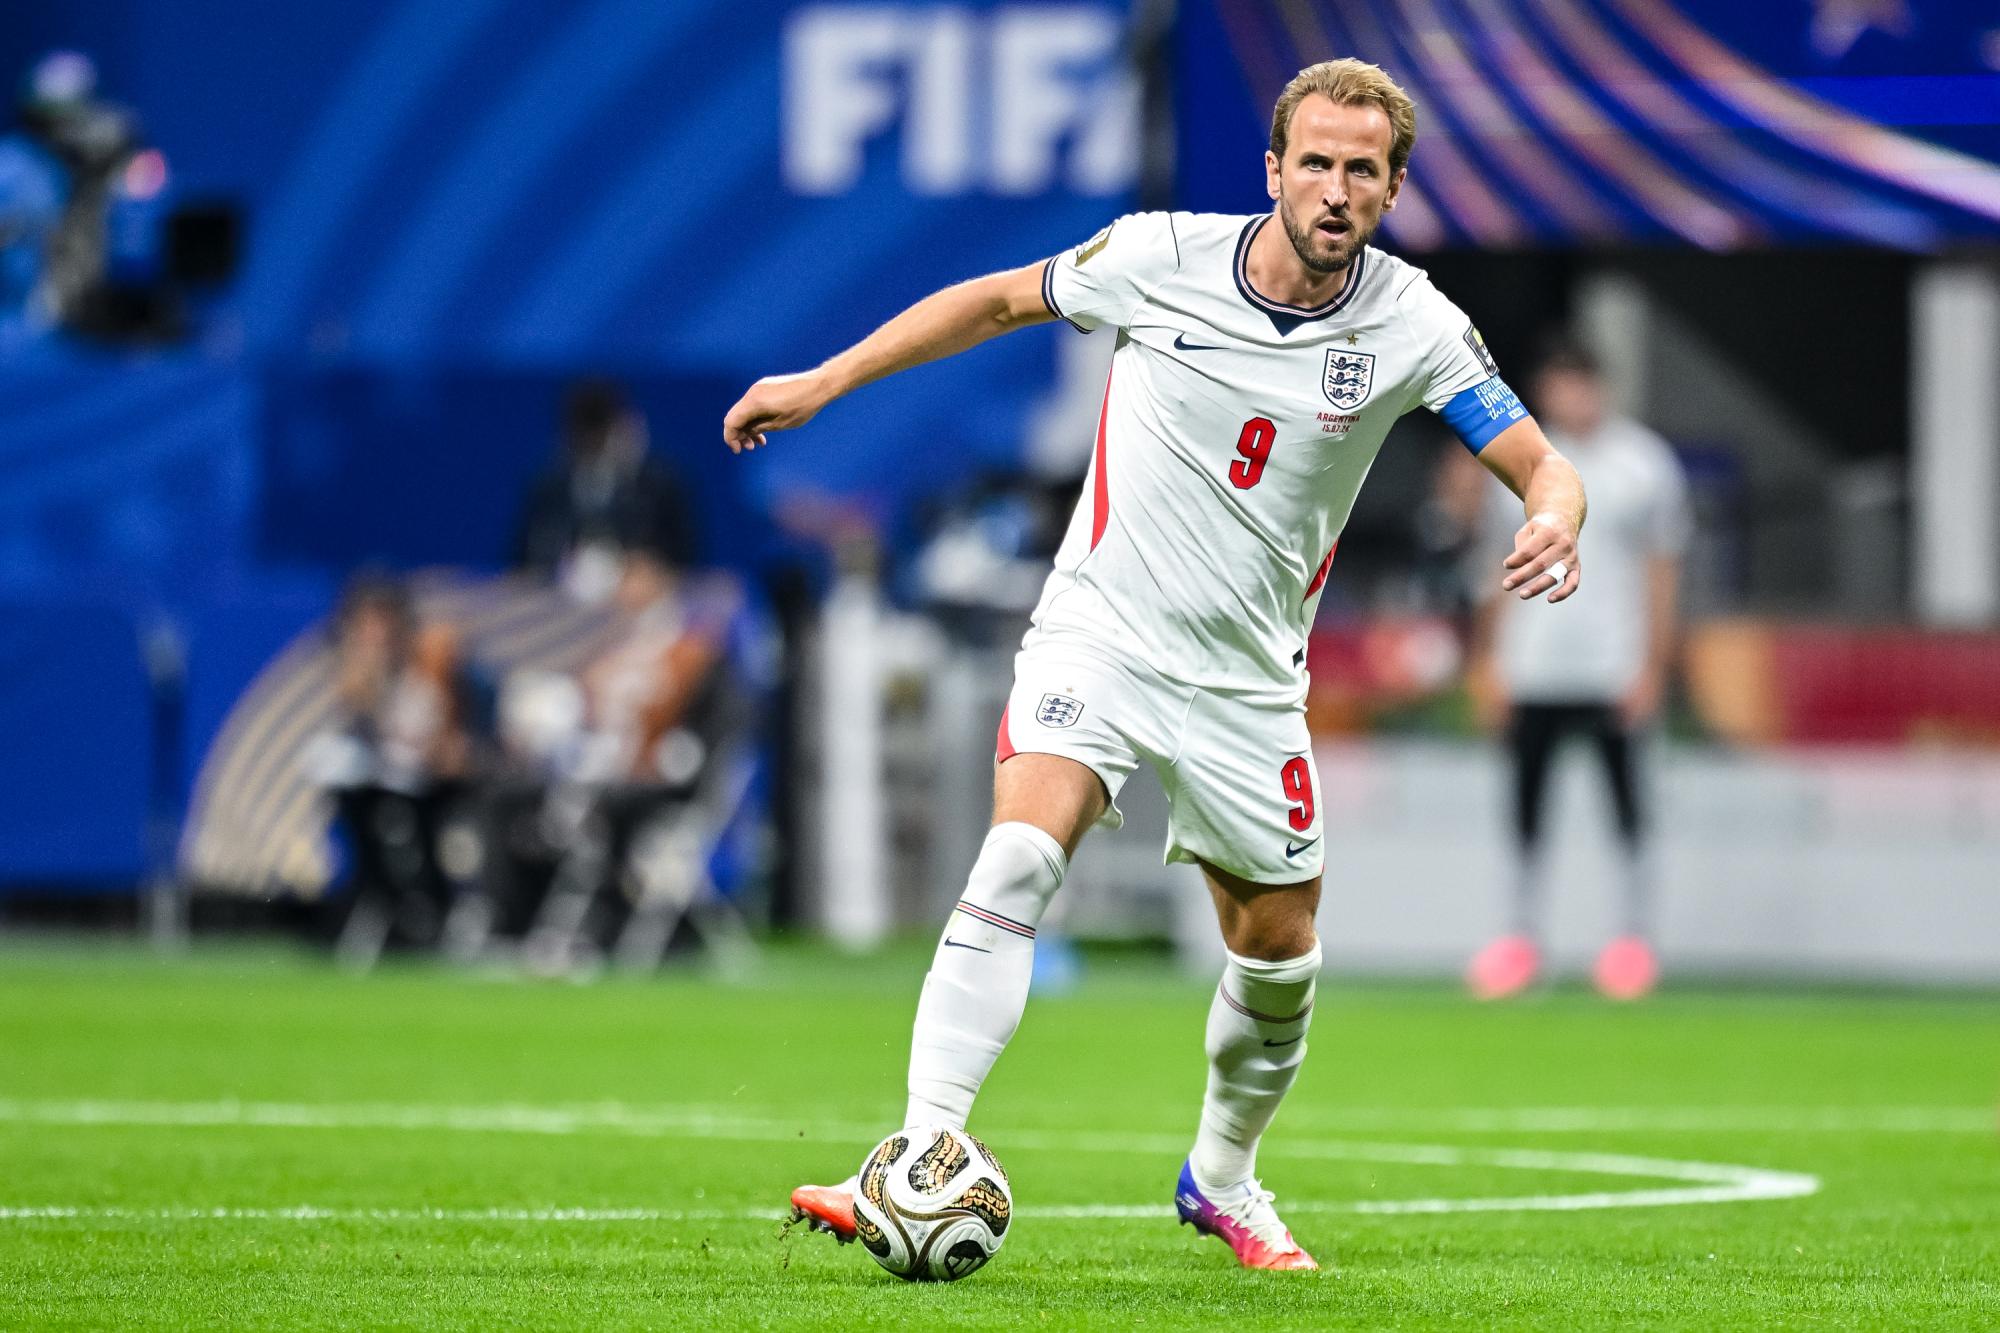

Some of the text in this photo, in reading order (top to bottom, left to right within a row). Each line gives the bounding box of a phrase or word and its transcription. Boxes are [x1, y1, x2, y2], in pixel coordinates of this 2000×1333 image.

[1316, 412, 1361, 423] ARGENTINA
[1480, 383, 1512, 409] UNITE
[1228, 416, 1278, 490] 9
[1280, 755, 1315, 832] 9
